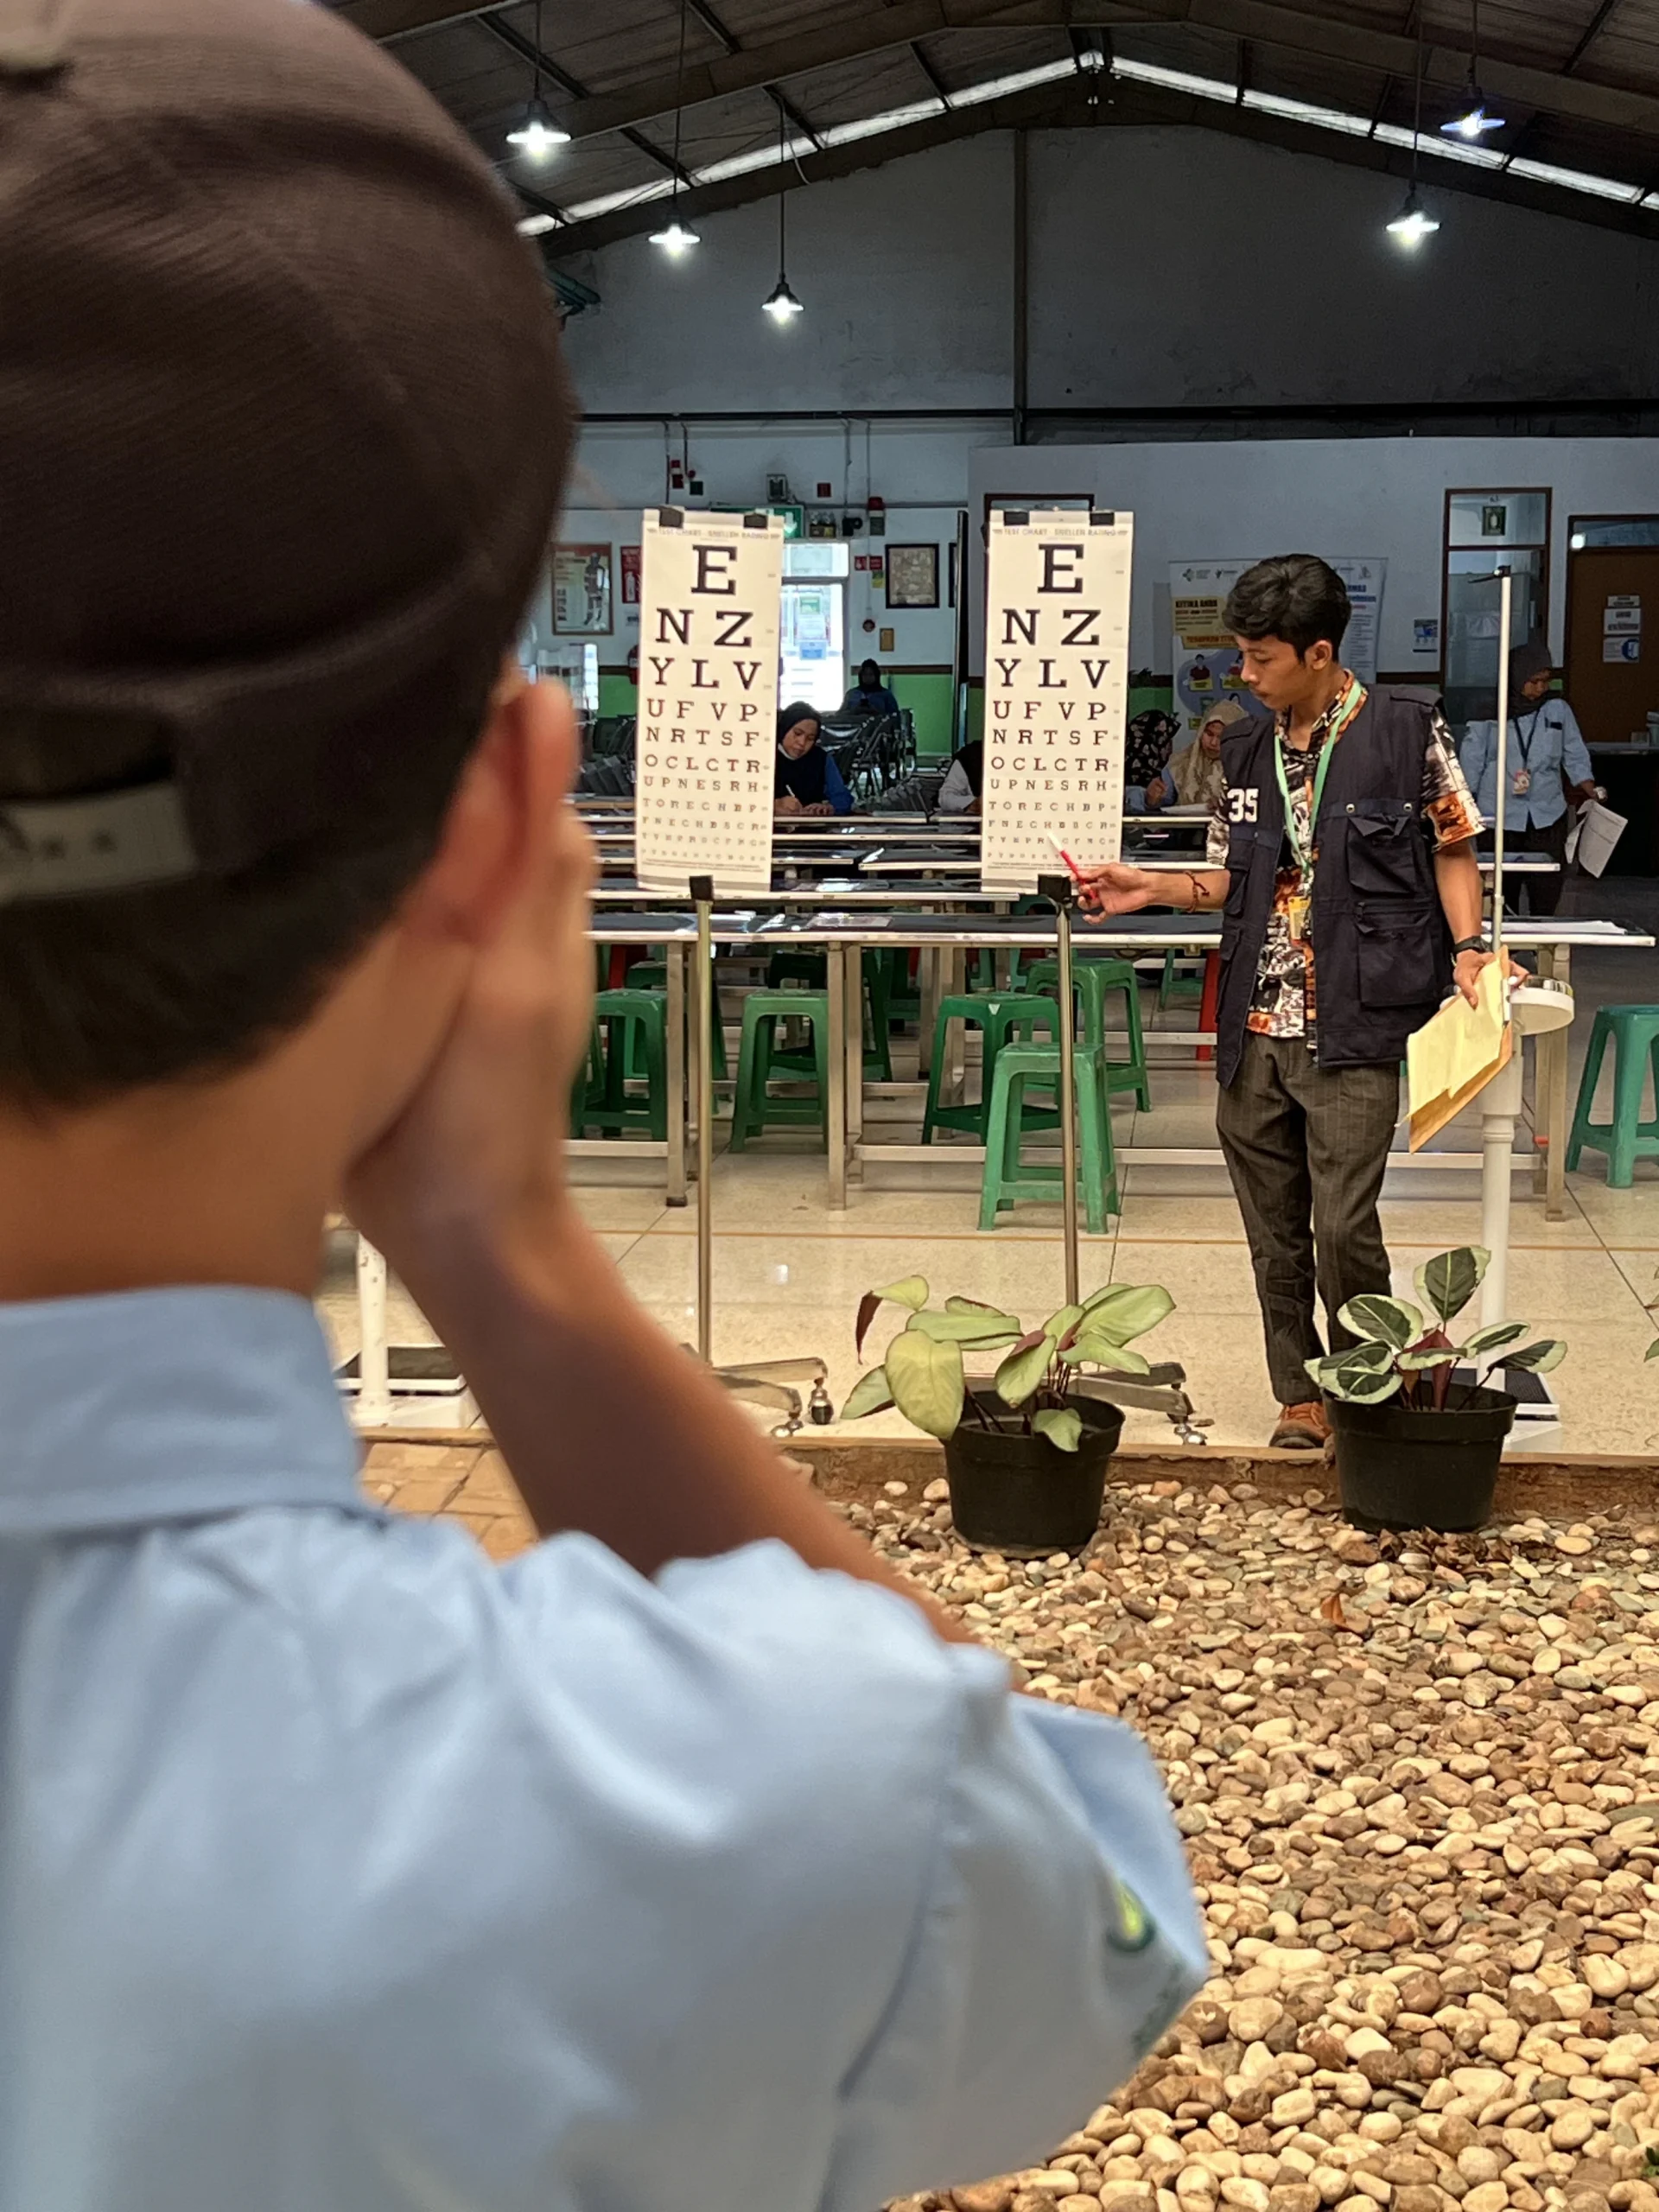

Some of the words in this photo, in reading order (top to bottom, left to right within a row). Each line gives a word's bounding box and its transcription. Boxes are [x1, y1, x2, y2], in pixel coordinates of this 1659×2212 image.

[691, 544, 737, 596] E
[1037, 543, 1084, 594] E
[1227, 787, 1259, 823] 35
